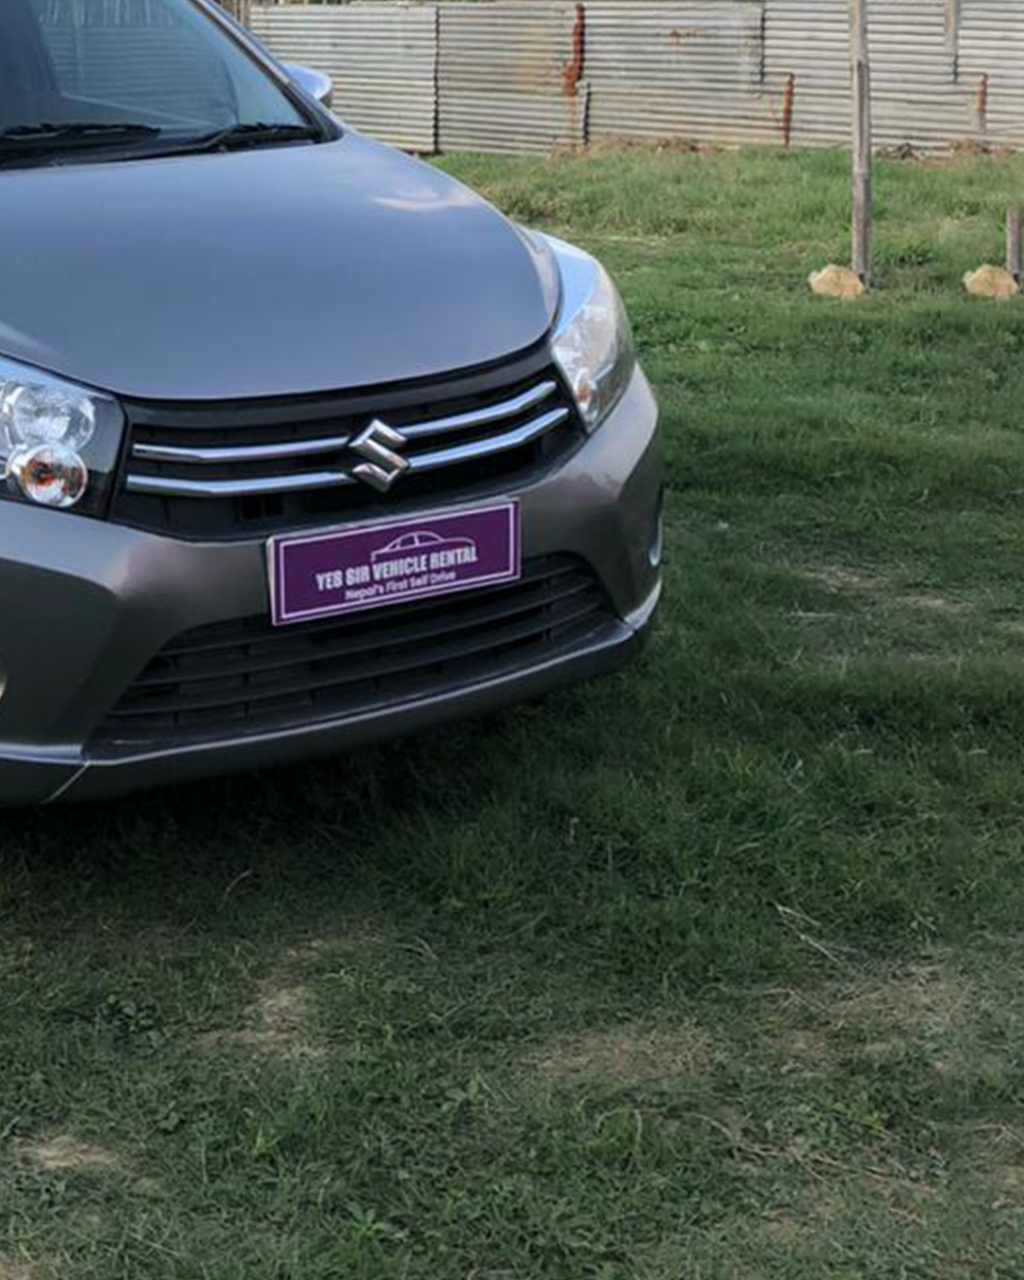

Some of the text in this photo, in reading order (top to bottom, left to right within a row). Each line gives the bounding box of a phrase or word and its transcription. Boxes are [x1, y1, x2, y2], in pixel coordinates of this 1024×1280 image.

[316, 547, 477, 591] YES SIR VEHICLE RENTAL
